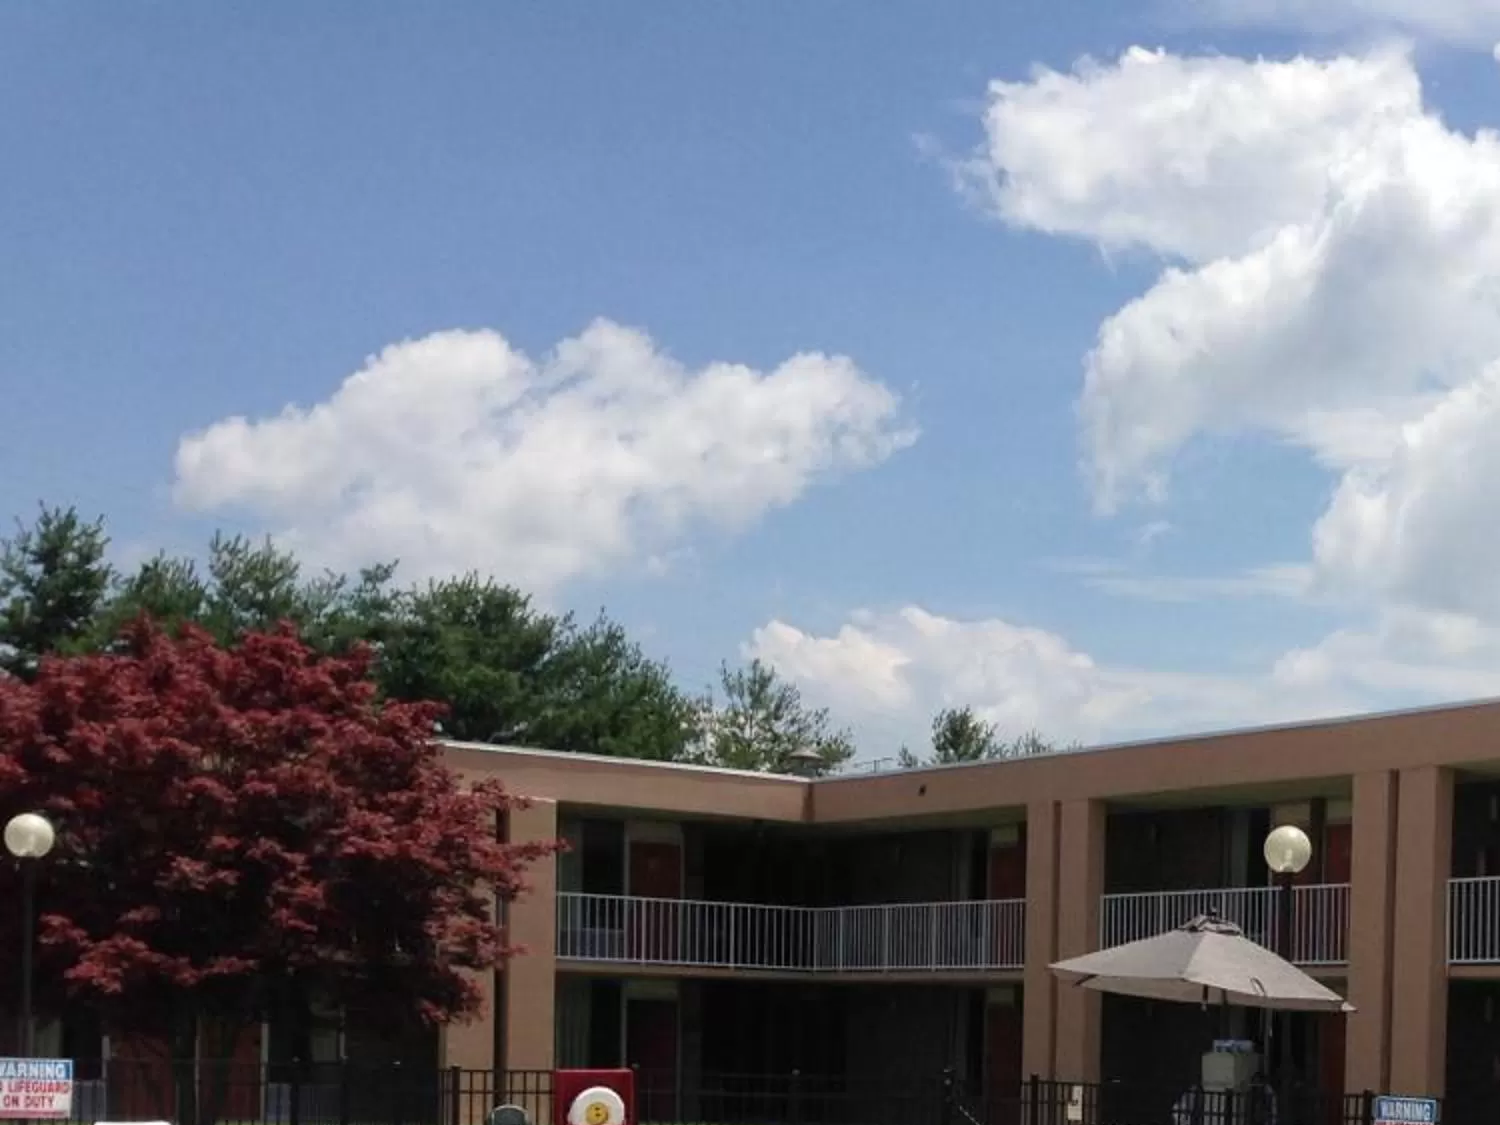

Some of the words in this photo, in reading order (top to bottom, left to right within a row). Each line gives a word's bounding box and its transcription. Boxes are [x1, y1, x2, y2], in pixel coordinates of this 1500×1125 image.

[8, 1081, 69, 1093] LIFEGUARD
[3, 1095, 20, 1108] ON
[24, 1096, 54, 1108] DUTY
[1380, 1101, 1431, 1121] WARNING
